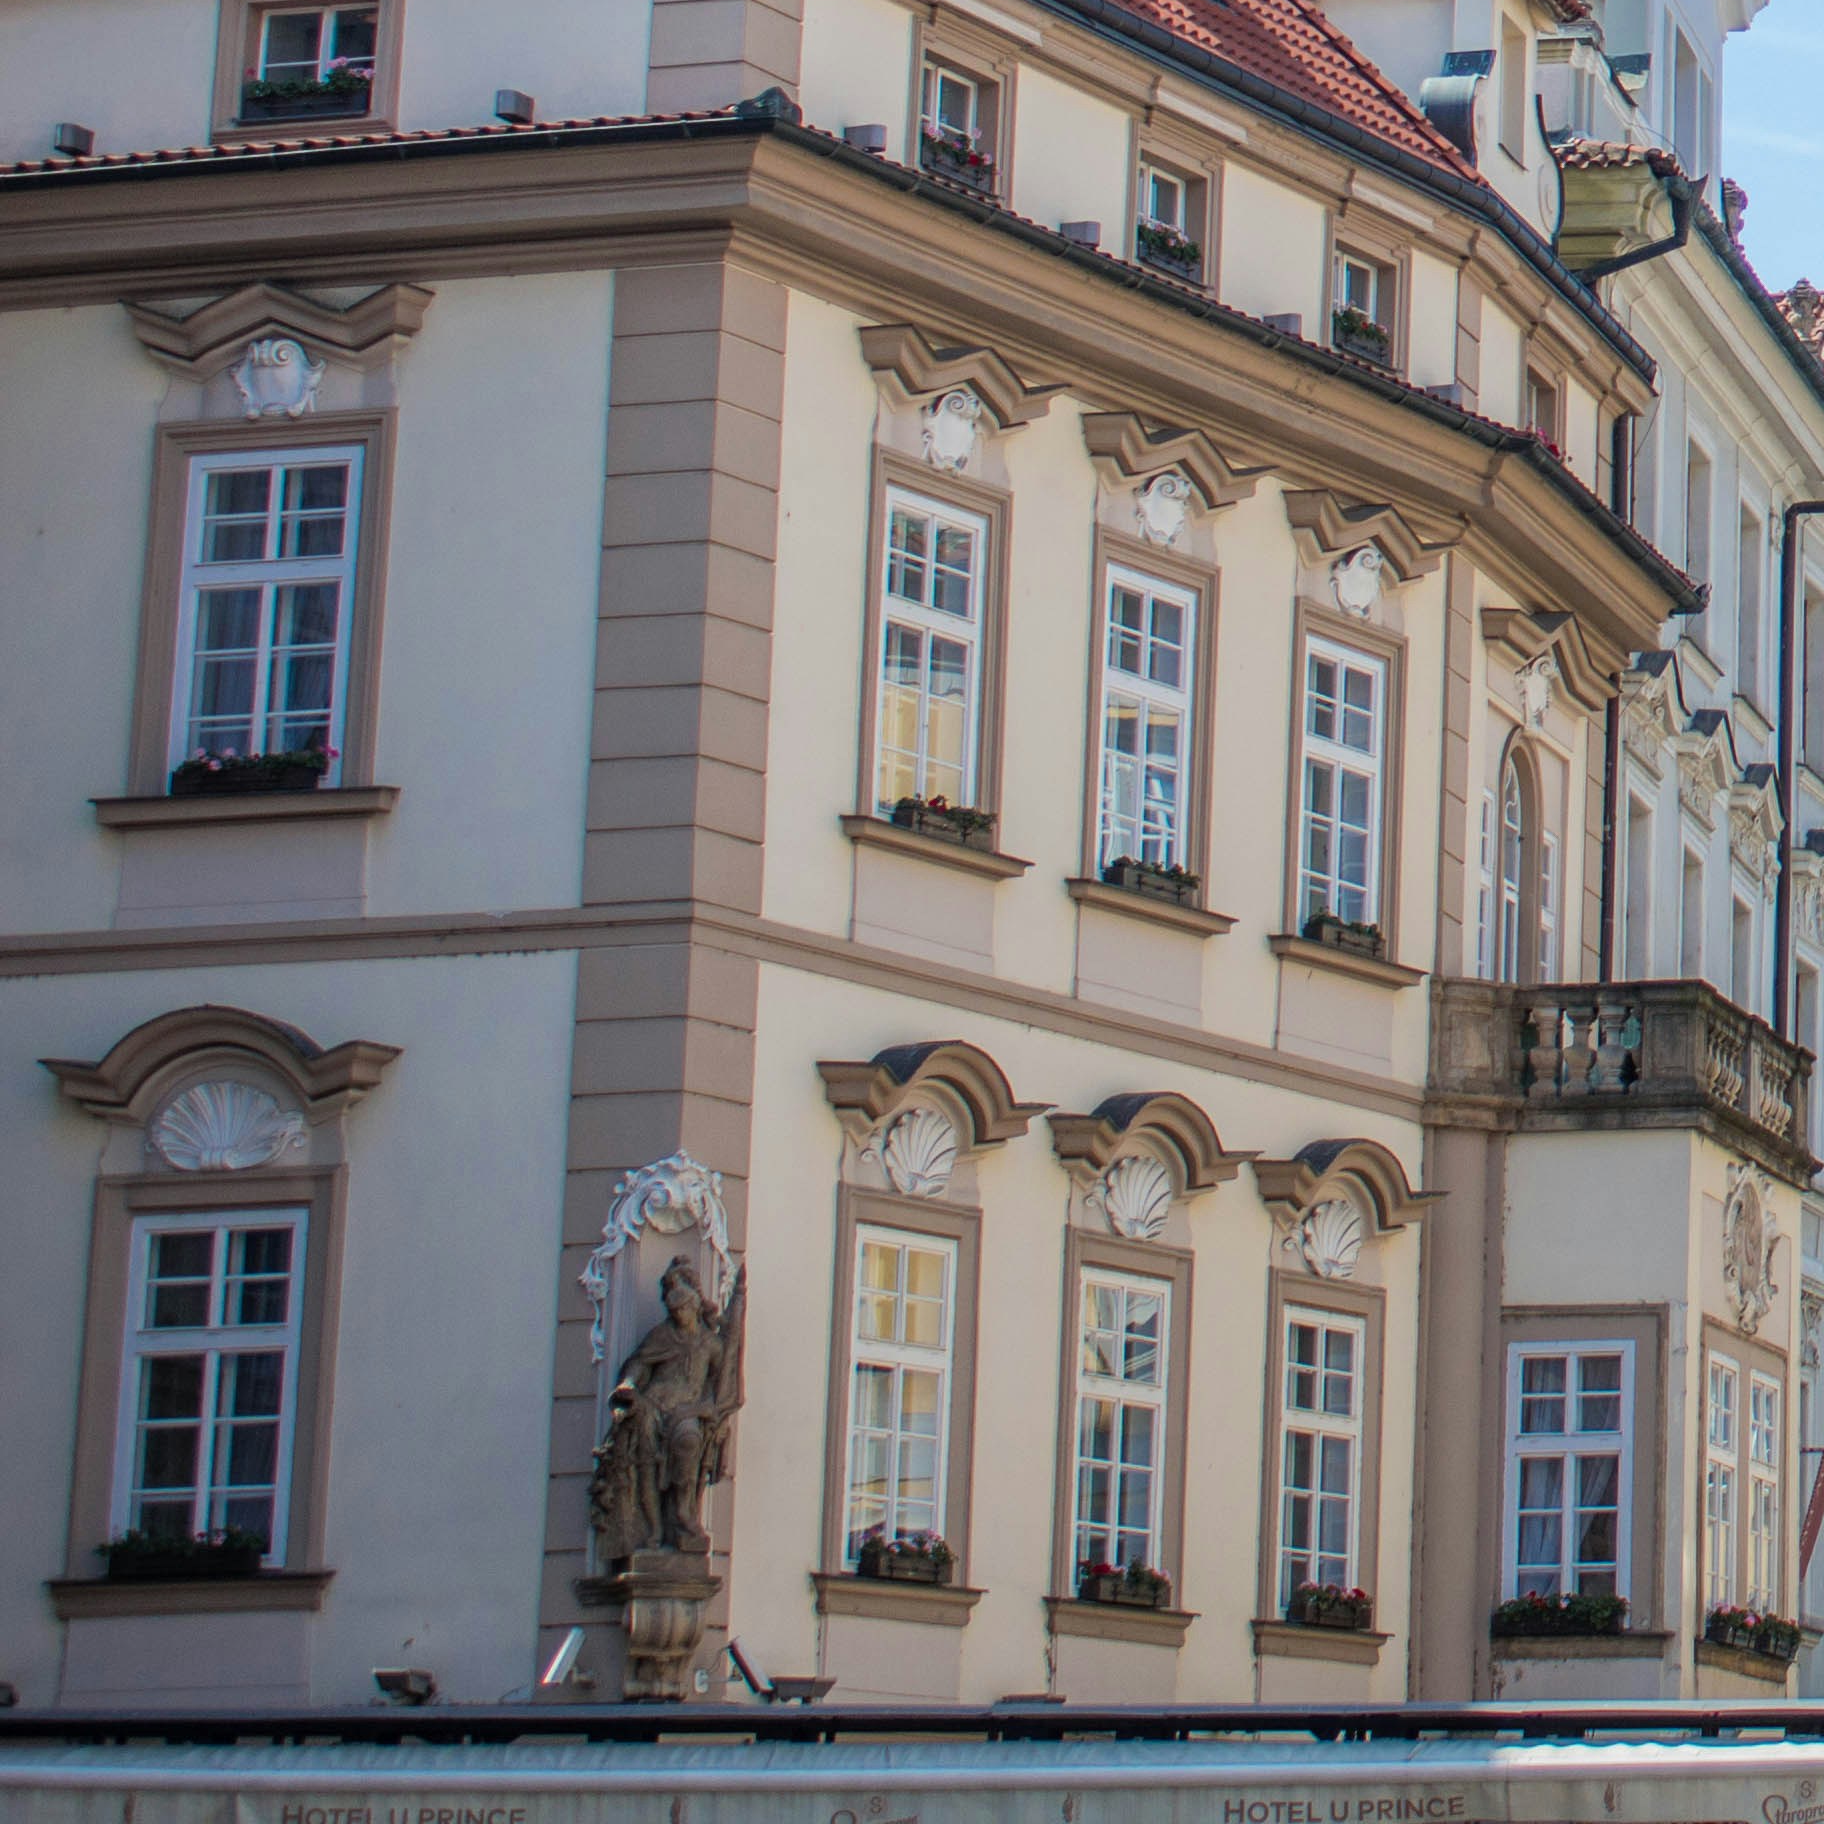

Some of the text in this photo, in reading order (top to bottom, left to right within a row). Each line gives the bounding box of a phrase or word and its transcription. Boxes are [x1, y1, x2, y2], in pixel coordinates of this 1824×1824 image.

[1224, 1796, 1465, 1823] HOTEL U PRINCE
